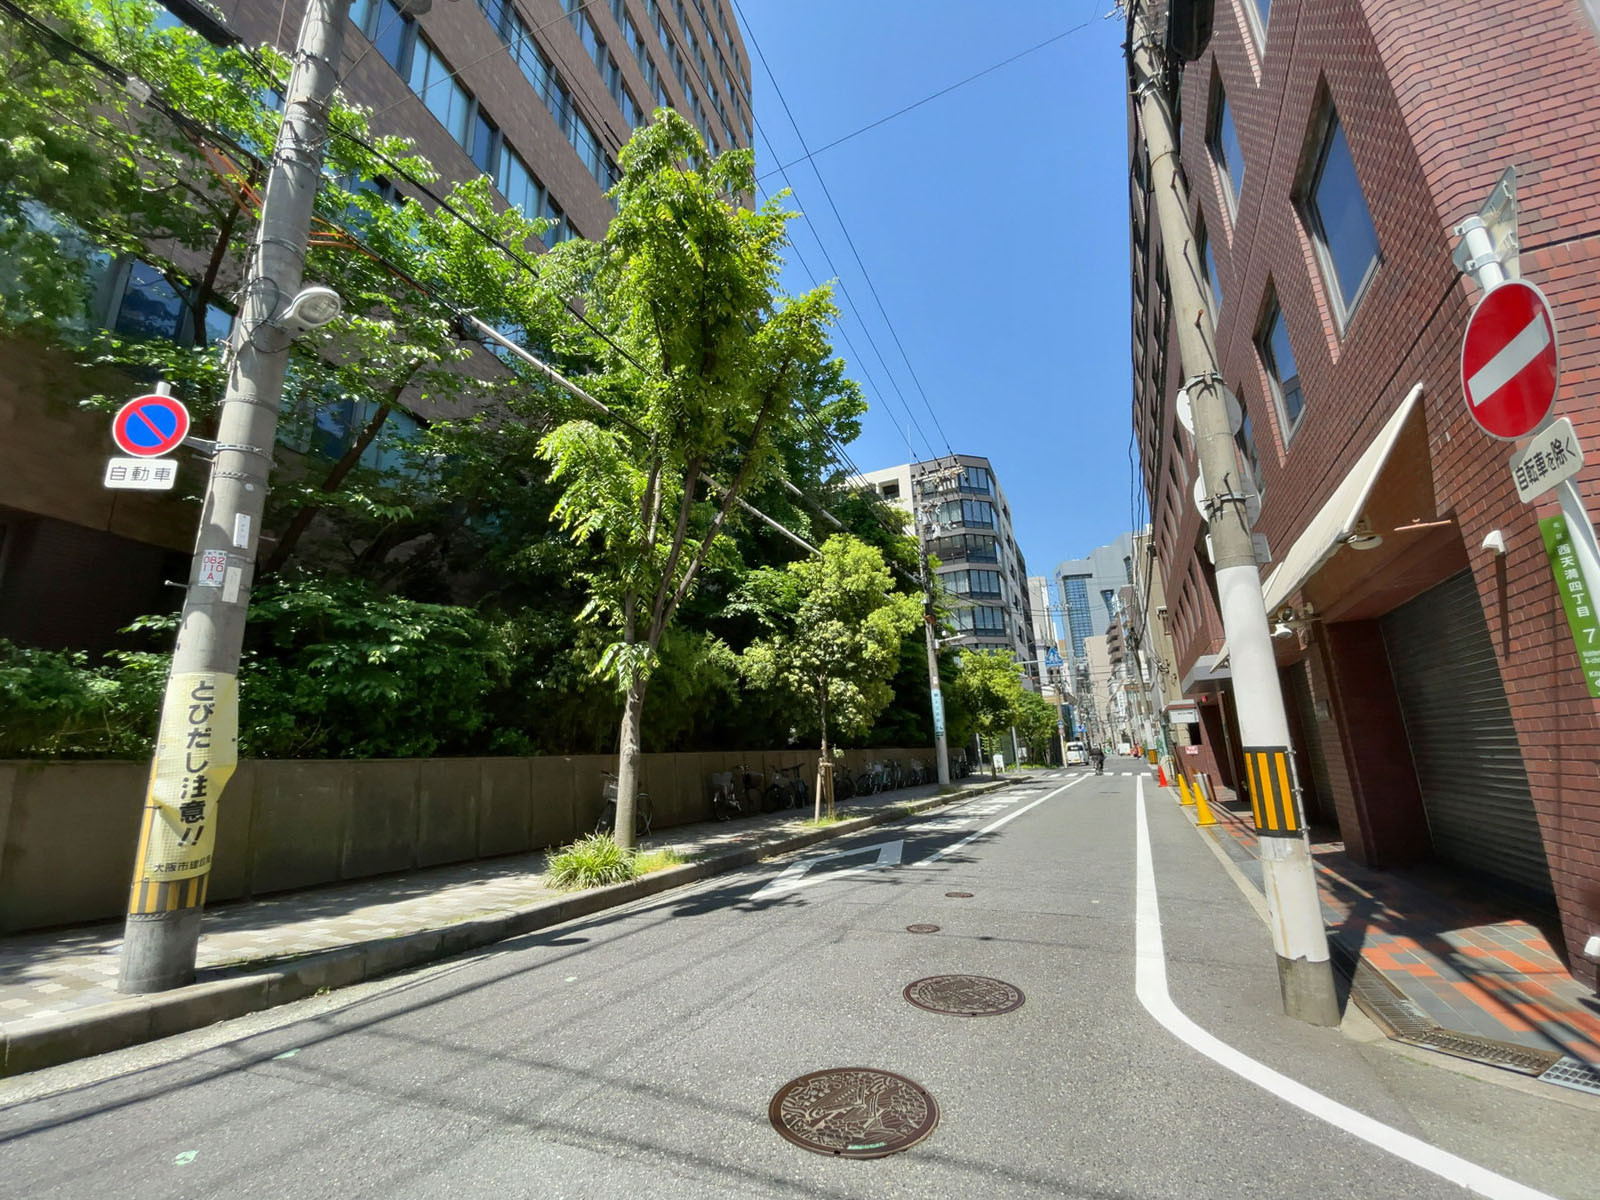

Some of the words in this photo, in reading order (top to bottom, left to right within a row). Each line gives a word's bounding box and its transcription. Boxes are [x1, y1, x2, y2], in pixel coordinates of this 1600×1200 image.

[1515, 436, 1576, 491] 自転車を除く
[109, 466, 172, 482] 自動車
[203, 556, 225, 565] 082
[203, 564, 224, 573] 110
[207, 572, 214, 580] A
[1556, 543, 1590, 618] 西天満四丁目
[1582, 628, 1596, 644] 7
